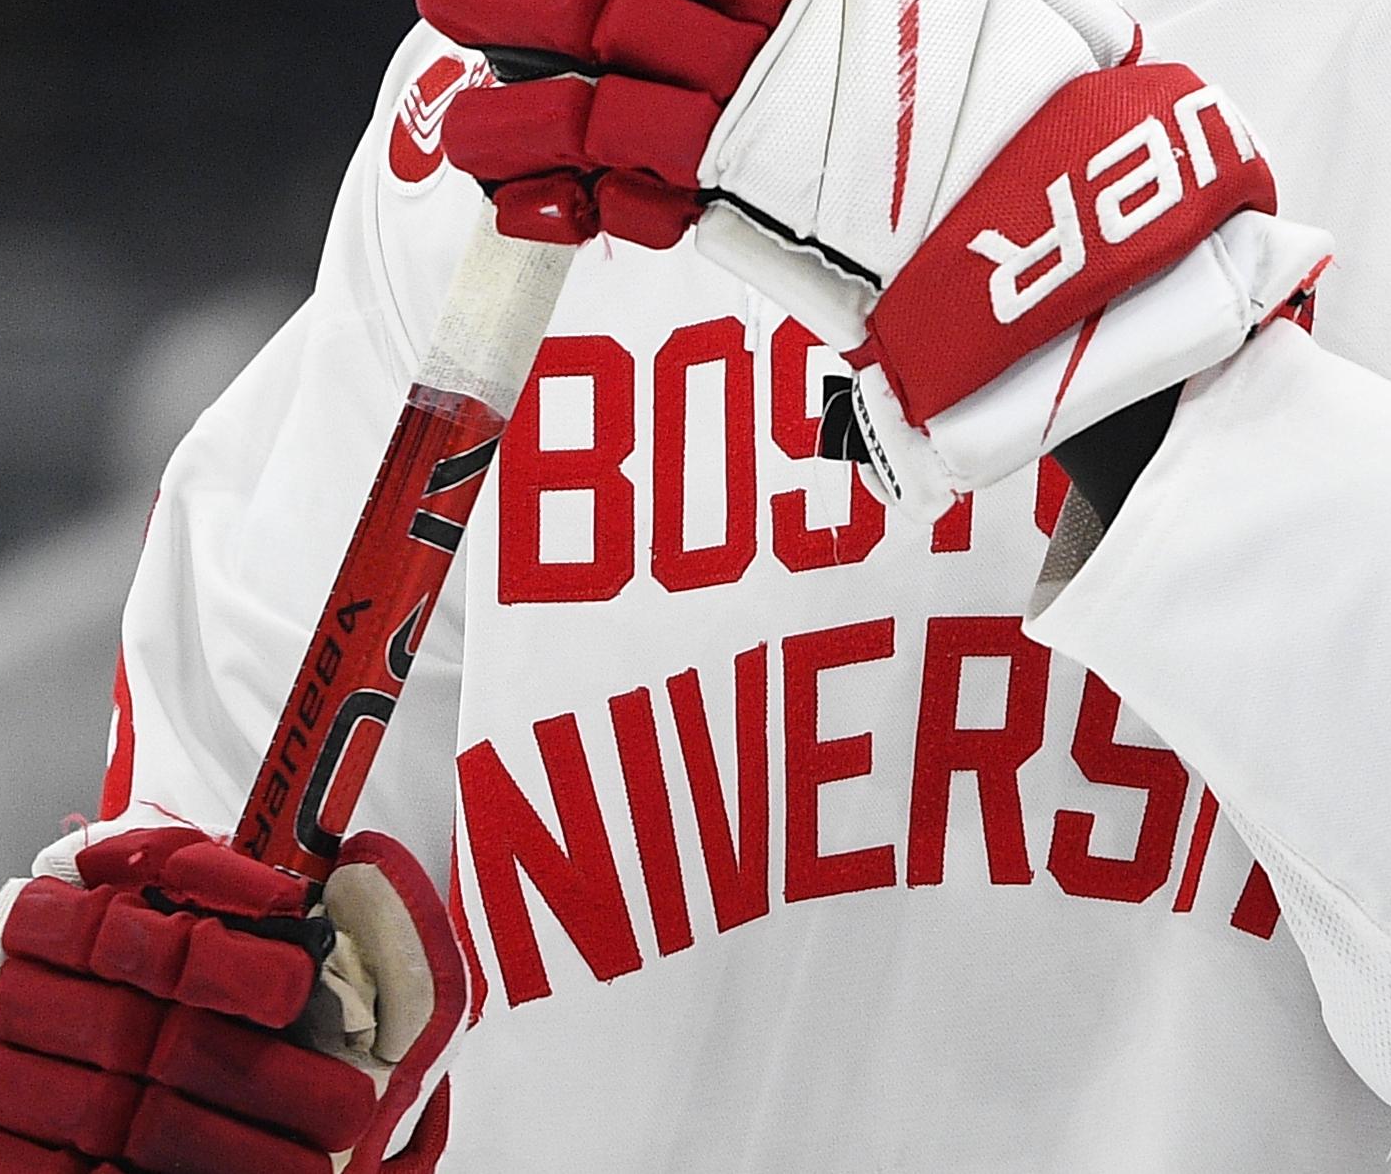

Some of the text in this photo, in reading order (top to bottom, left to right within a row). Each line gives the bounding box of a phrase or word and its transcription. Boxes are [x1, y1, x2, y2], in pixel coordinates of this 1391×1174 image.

[965, 84, 1262, 326] UER
[496, 316, 1075, 606] BOS
[243, 649, 343, 860] BAUER
[449, 616, 1280, 1030] NIVERS
